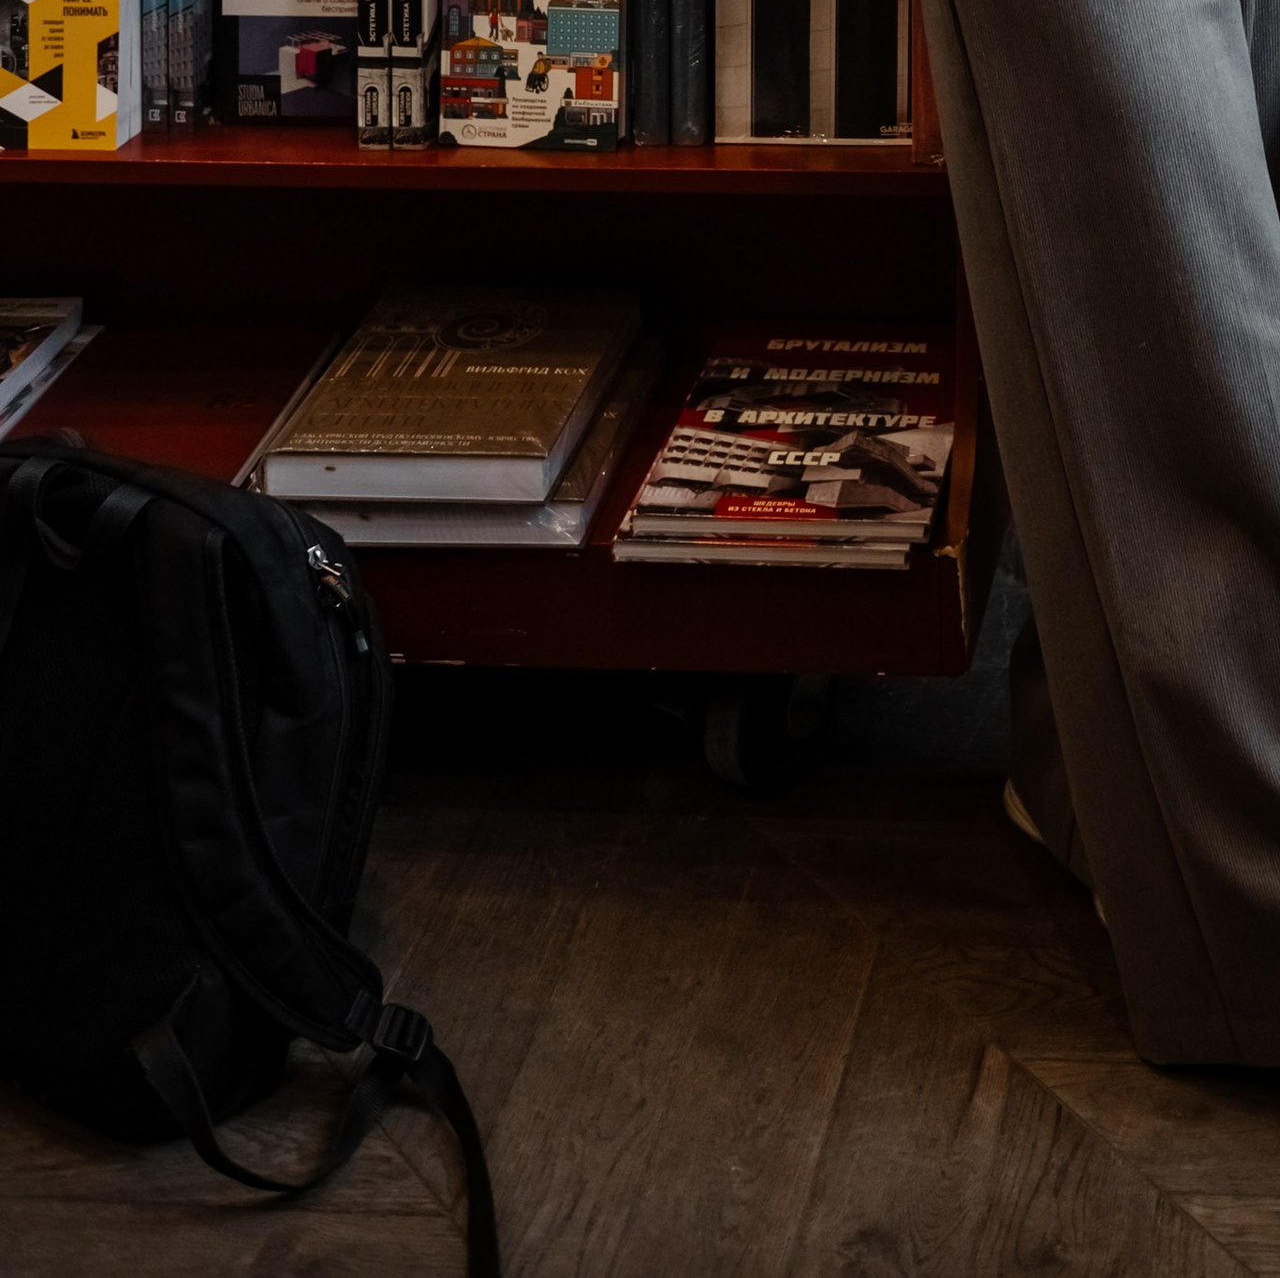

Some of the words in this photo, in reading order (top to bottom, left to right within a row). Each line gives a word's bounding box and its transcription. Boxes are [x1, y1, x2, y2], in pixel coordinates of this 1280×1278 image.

[62, 5, 109, 18] ПОНИМАТЬ
[369, 2, 377, 43] ЭСТЕТИКА
[403, 2, 411, 43] ЭСТЕТИКА
[237, 83, 265, 100] STUDIA
[237, 100, 278, 117] URBANICA
[477, 130, 507, 139] СТРАНА
[766, 338, 928, 354] БРУТАЛИЗМ
[465, 365, 551, 375] ВИЛЬФРИД
[553, 366, 590, 376] КОХ
[728, 366, 750, 380] И
[763, 367, 940, 385] МОДЕРНИЗМ
[702, 409, 726, 423] В
[737, 410, 937, 429] АРХИТЕКТУРЕ
[767, 450, 842, 466] СССР
[752, 500, 796, 508] ШЕДЕВРЫ
[784, 506, 817, 514] БЕТОНА
